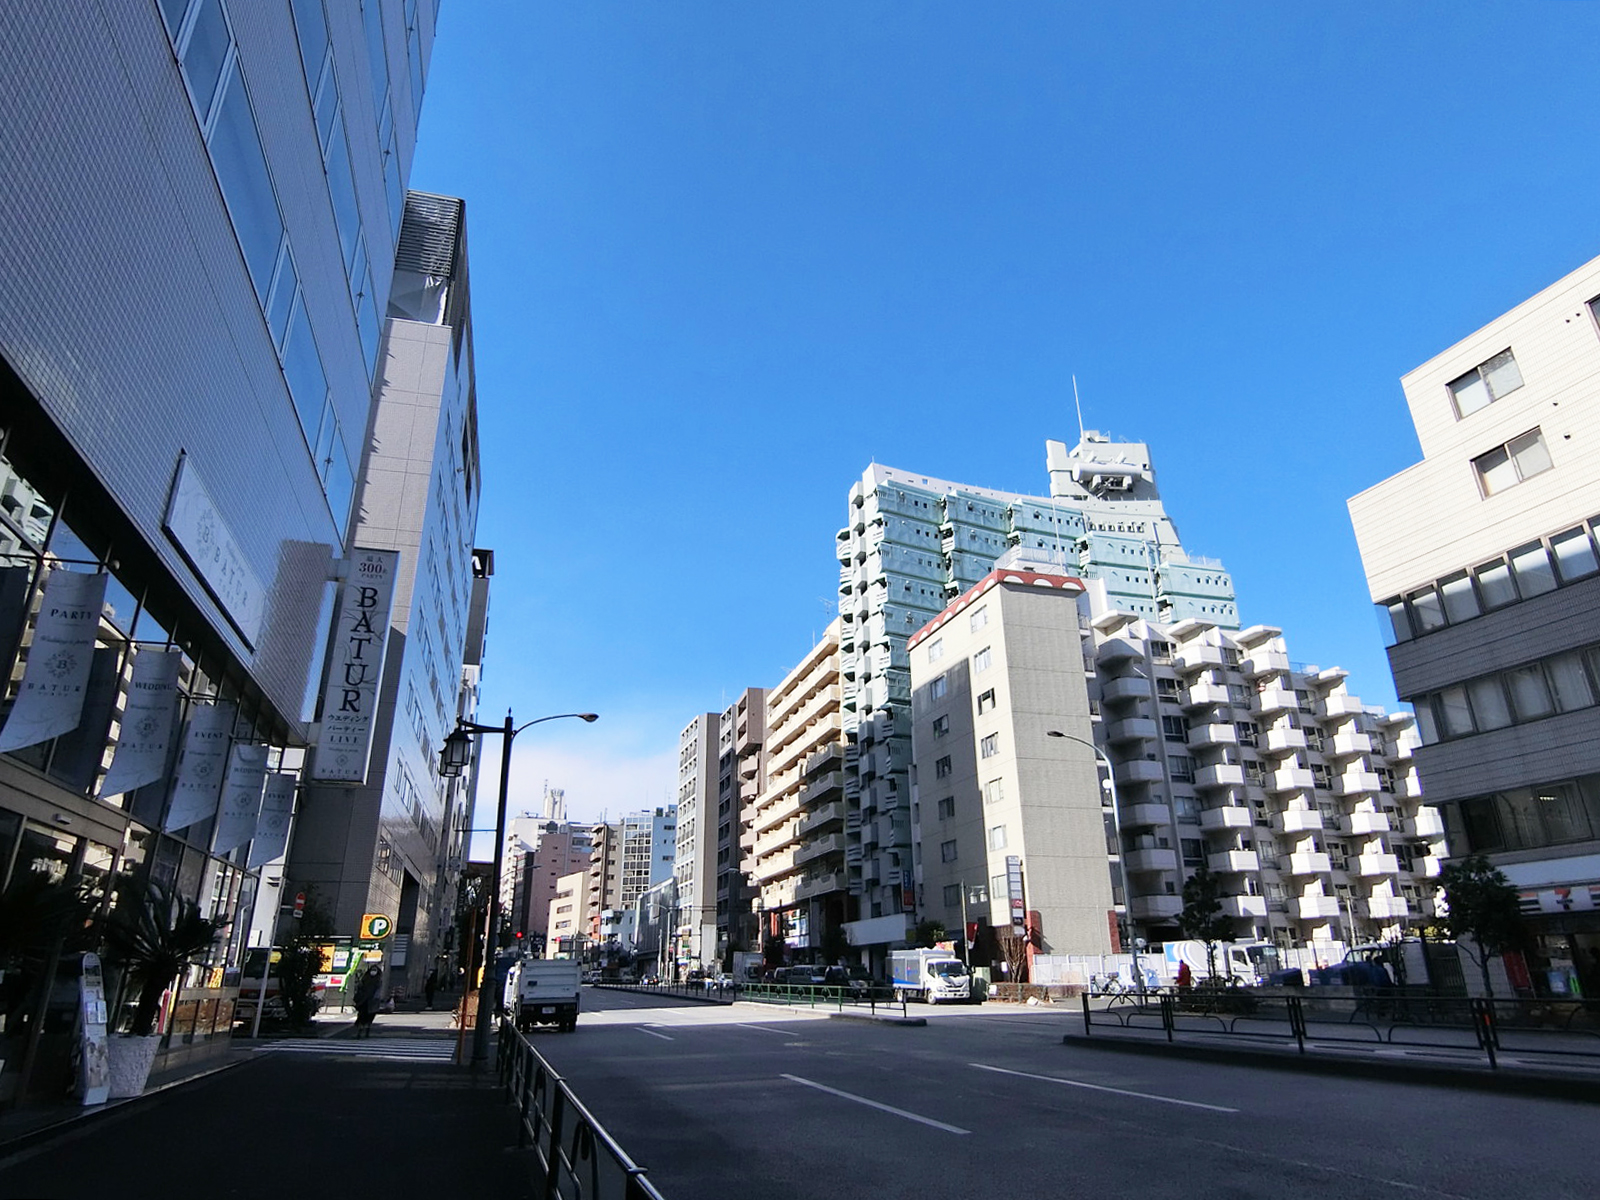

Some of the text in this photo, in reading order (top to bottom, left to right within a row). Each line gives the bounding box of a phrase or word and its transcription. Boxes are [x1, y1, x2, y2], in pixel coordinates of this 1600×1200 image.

[214, 546, 249, 606] BATUR
[50, 608, 93, 620] PARTY
[339, 586, 379, 713] BATUR
[28, 683, 82, 692] BATUR
[134, 681, 174, 691] WEDDING
[195, 731, 224, 739] EVENT
[330, 735, 358, 744] LIVE
[373, 919, 387, 935] P
